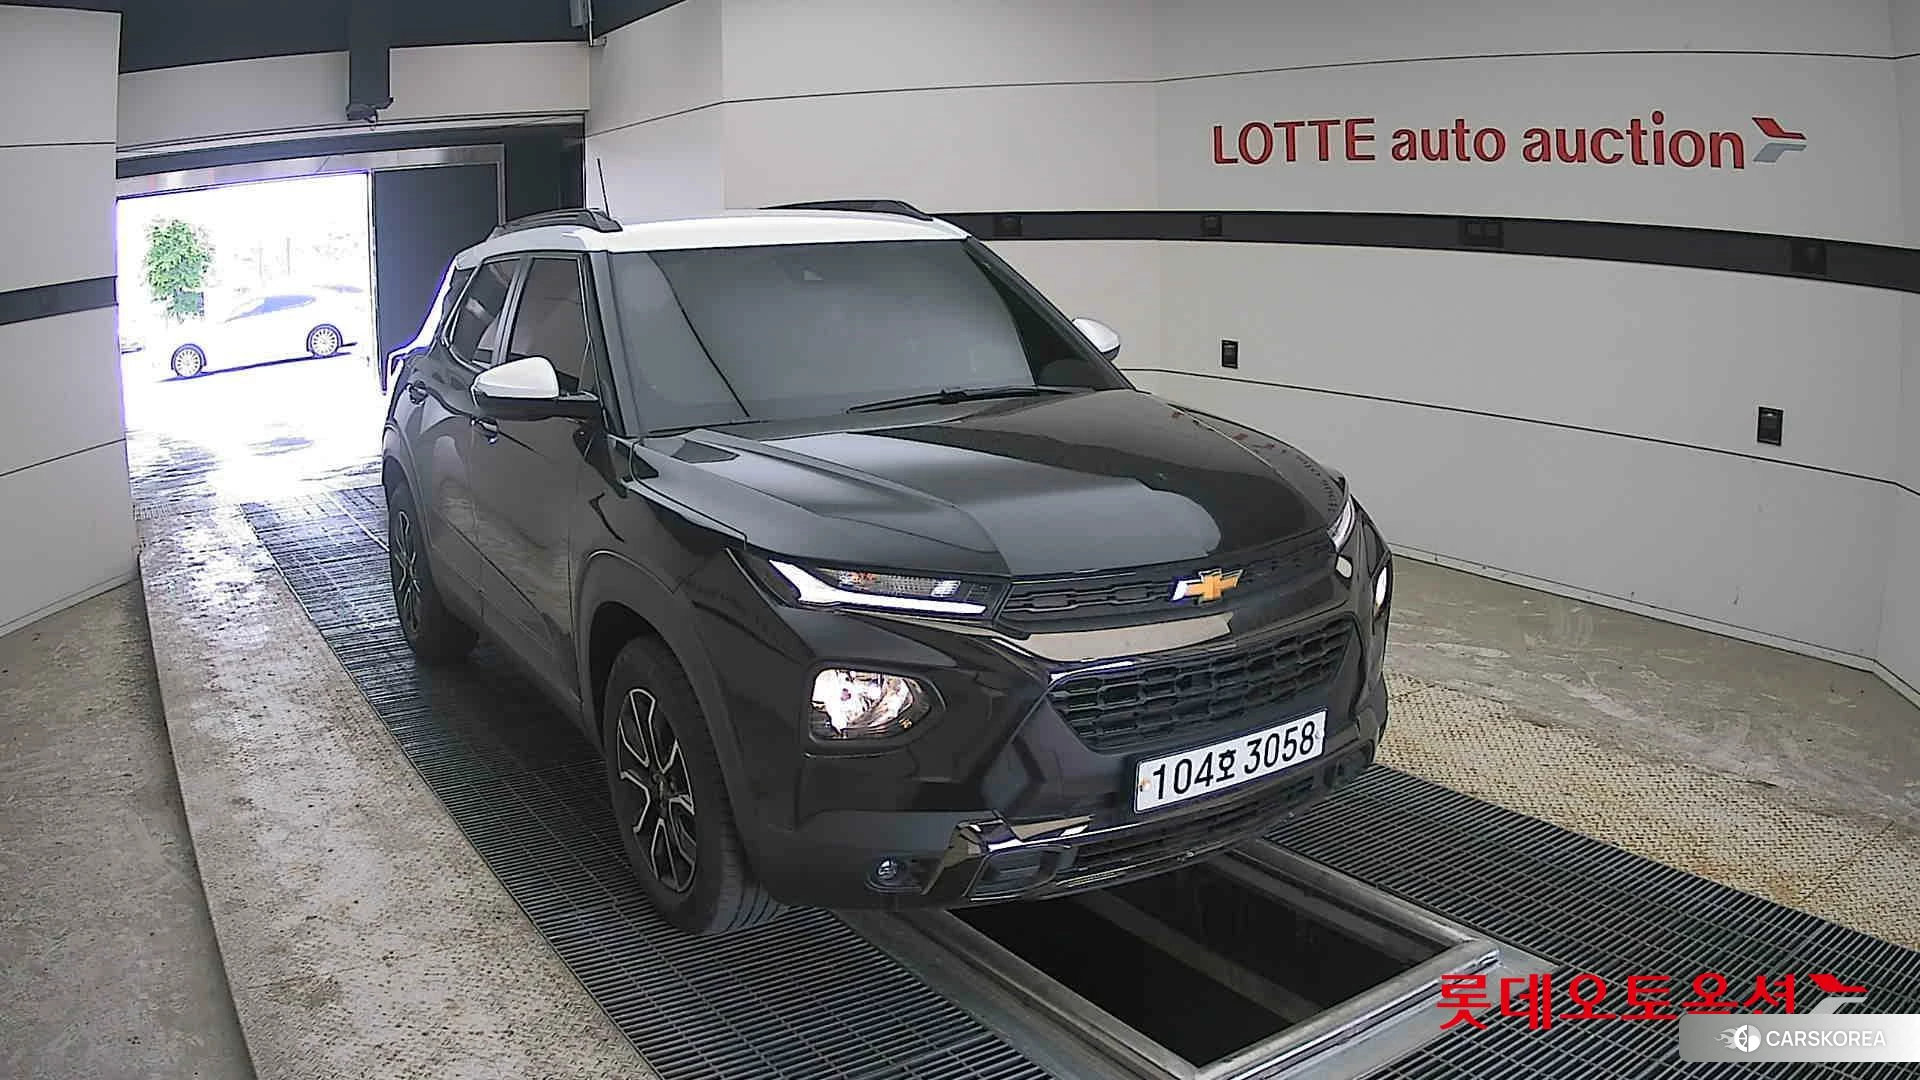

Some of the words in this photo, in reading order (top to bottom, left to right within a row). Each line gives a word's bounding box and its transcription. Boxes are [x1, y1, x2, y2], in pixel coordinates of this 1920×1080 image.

[1212, 117, 1376, 165] LOTTE
[1391, 117, 1507, 162] auto
[1521, 110, 1746, 170] auction
[1152, 749, 1237, 801] 104호
[1243, 720, 1316, 775] 3058
